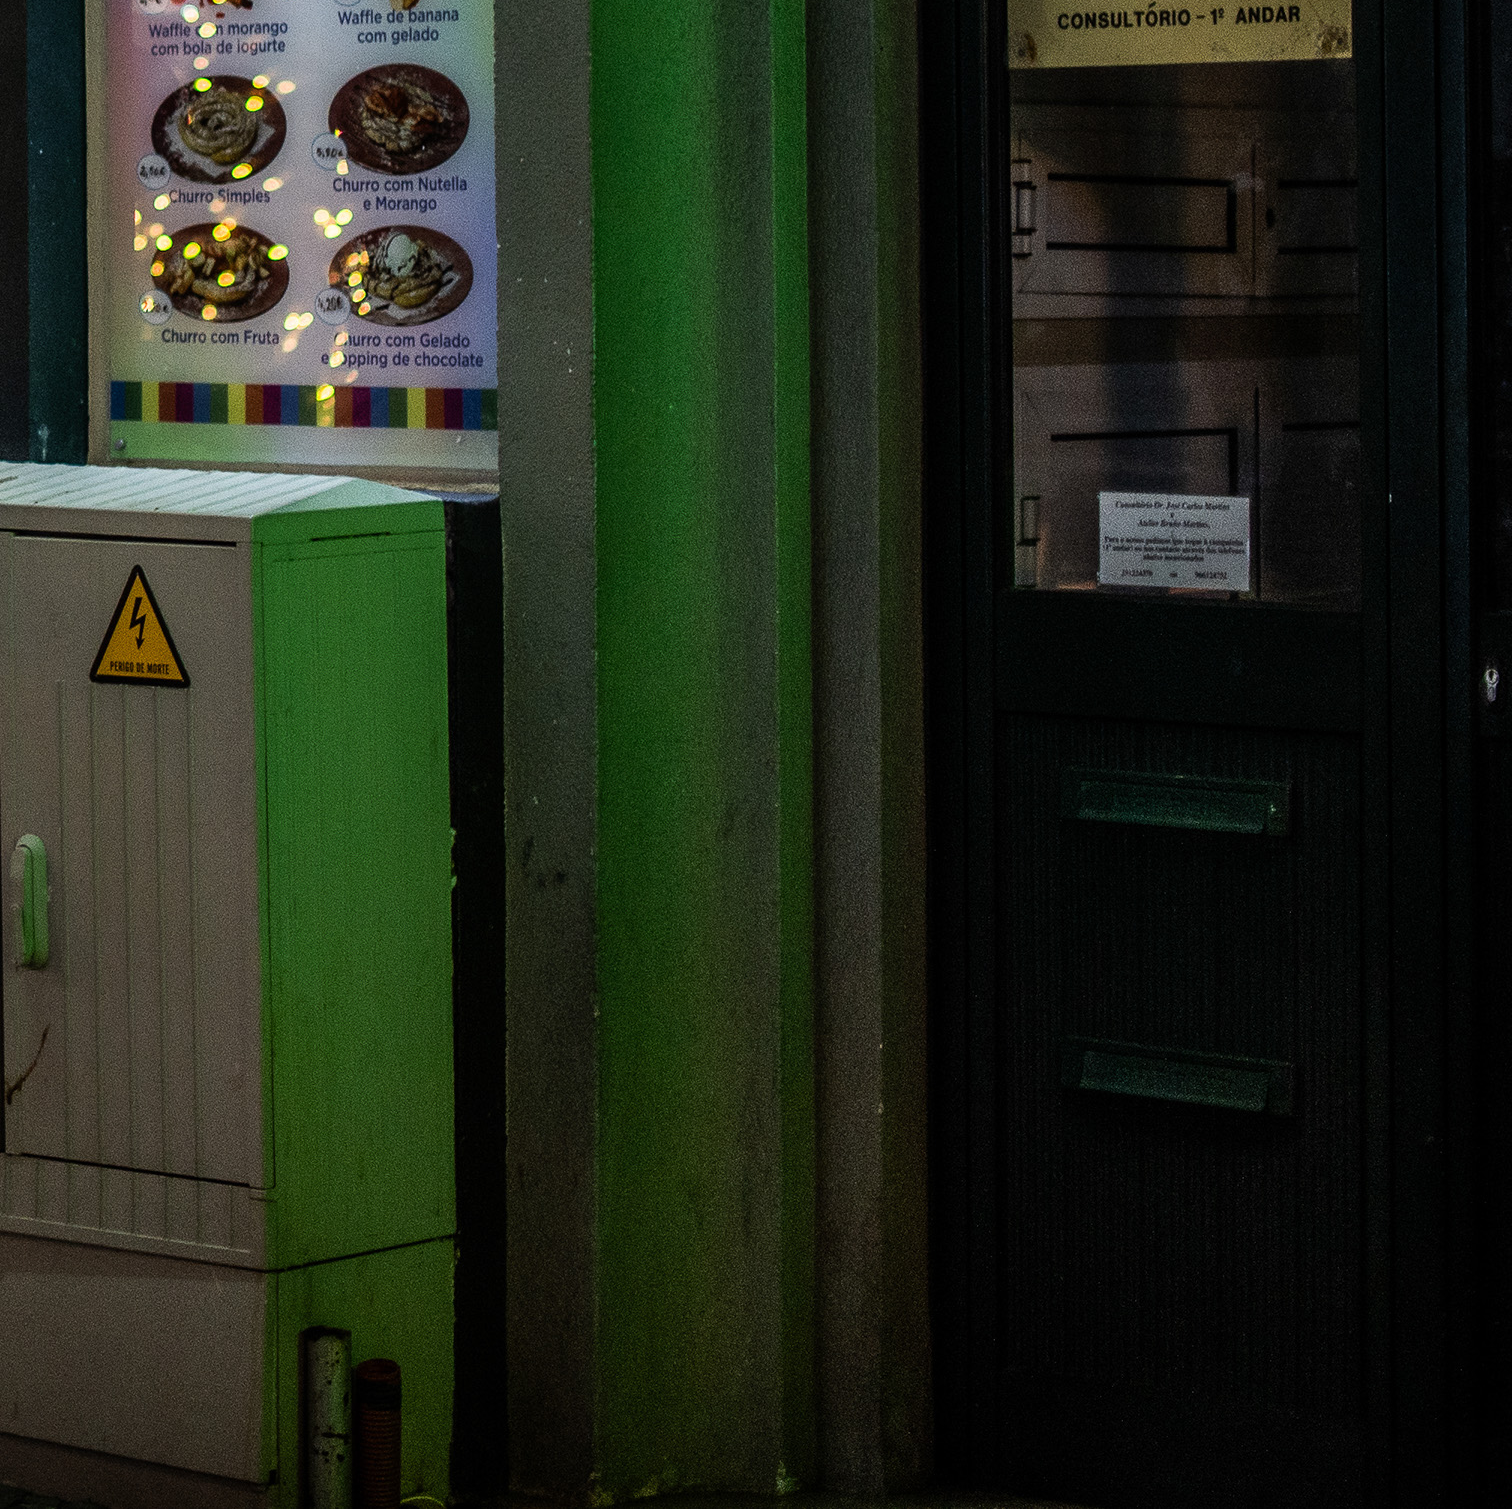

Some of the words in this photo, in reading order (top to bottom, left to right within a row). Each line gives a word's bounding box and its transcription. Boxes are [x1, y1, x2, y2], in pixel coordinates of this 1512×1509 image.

[337, 10, 383, 25] Waffle
[387, 10, 404, 24] de
[408, 9, 459, 23] banana
[1057, 1, 1191, 30] CONSULTÓRIO
[1235, 5, 1301, 23] ANDAR
[149, 23, 191, 38] Waffle
[228, 22, 288, 37] morango
[357, 31, 387, 43] com
[391, 26, 439, 45] gelado
[151, 43, 179, 56] com
[183, 41, 212, 55] bola
[216, 41, 232, 54] de
[237, 40, 286, 56] iogurte
[333, 177, 380, 192] Churro
[384, 179, 413, 191] com
[418, 176, 467, 191] Nutella
[169, 189, 214, 204] Churro
[217, 188, 270, 205] Simples
[363, 199, 371, 210] e
[376, 196, 437, 212] Morango
[161, 329, 206, 344] Churro
[211, 331, 239, 344] com
[243, 330, 280, 345] Fruta
[385, 334, 416, 347] com
[420, 333, 470, 348] Gelado
[331, 352, 388, 369] opping
[392, 352, 410, 366] de
[414, 352, 484, 367] chocolate
[110, 660, 134, 672] PERIGO
[136, 662, 145, 673] DE
[147, 663, 170, 674] MORTE
